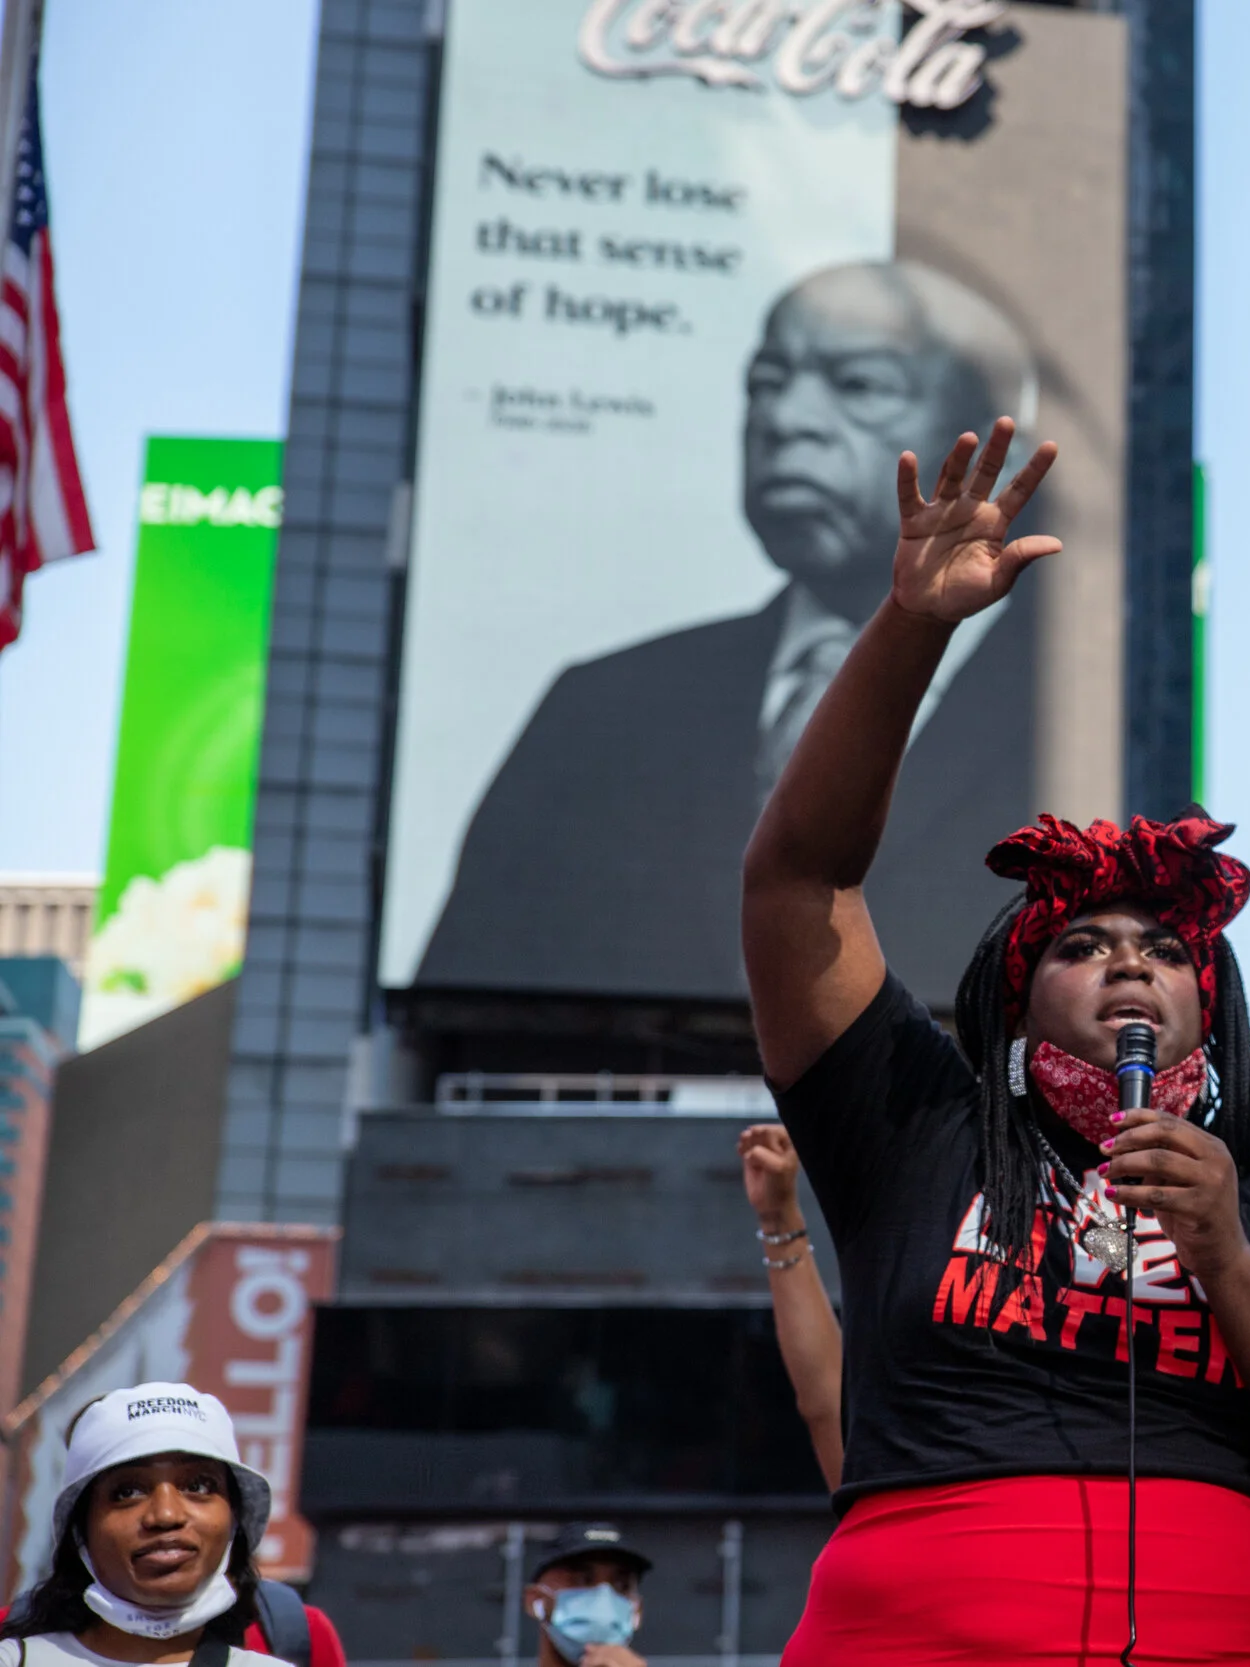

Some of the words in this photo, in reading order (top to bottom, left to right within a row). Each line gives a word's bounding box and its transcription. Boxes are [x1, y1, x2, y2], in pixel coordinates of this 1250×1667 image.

[479, 149, 630, 203] Never
[645, 168, 747, 214] lose
[476, 217, 582, 262] that
[599, 234, 744, 275] sense
[471, 281, 531, 318] of
[545, 283, 692, 338] hope.
[127, 1397, 199, 1412] FREEDOM
